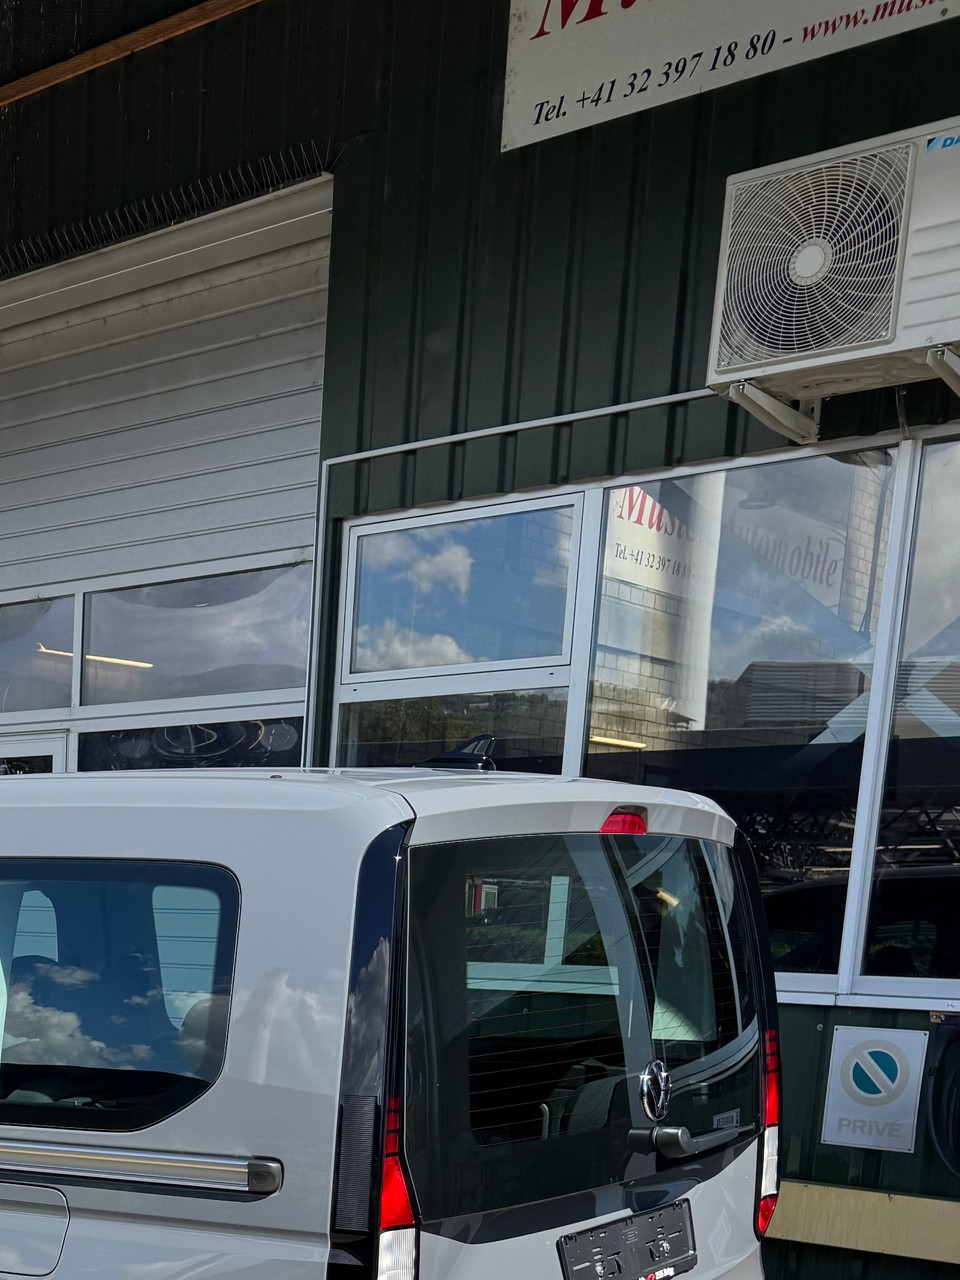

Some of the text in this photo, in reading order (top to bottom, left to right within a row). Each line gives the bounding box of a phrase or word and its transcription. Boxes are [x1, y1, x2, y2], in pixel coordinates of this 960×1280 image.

[533, 94, 567, 126] Tel.
[575, 78, 617, 109] +41
[623, 68, 652, 98] 32
[657, 52, 704, 87] 397
[708, 41, 739, 72] 18
[744, 29, 777, 61] 80
[615, 542, 627, 561] Tel.
[629, 549, 644, 566] +41
[644, 552, 656, 569] 32
